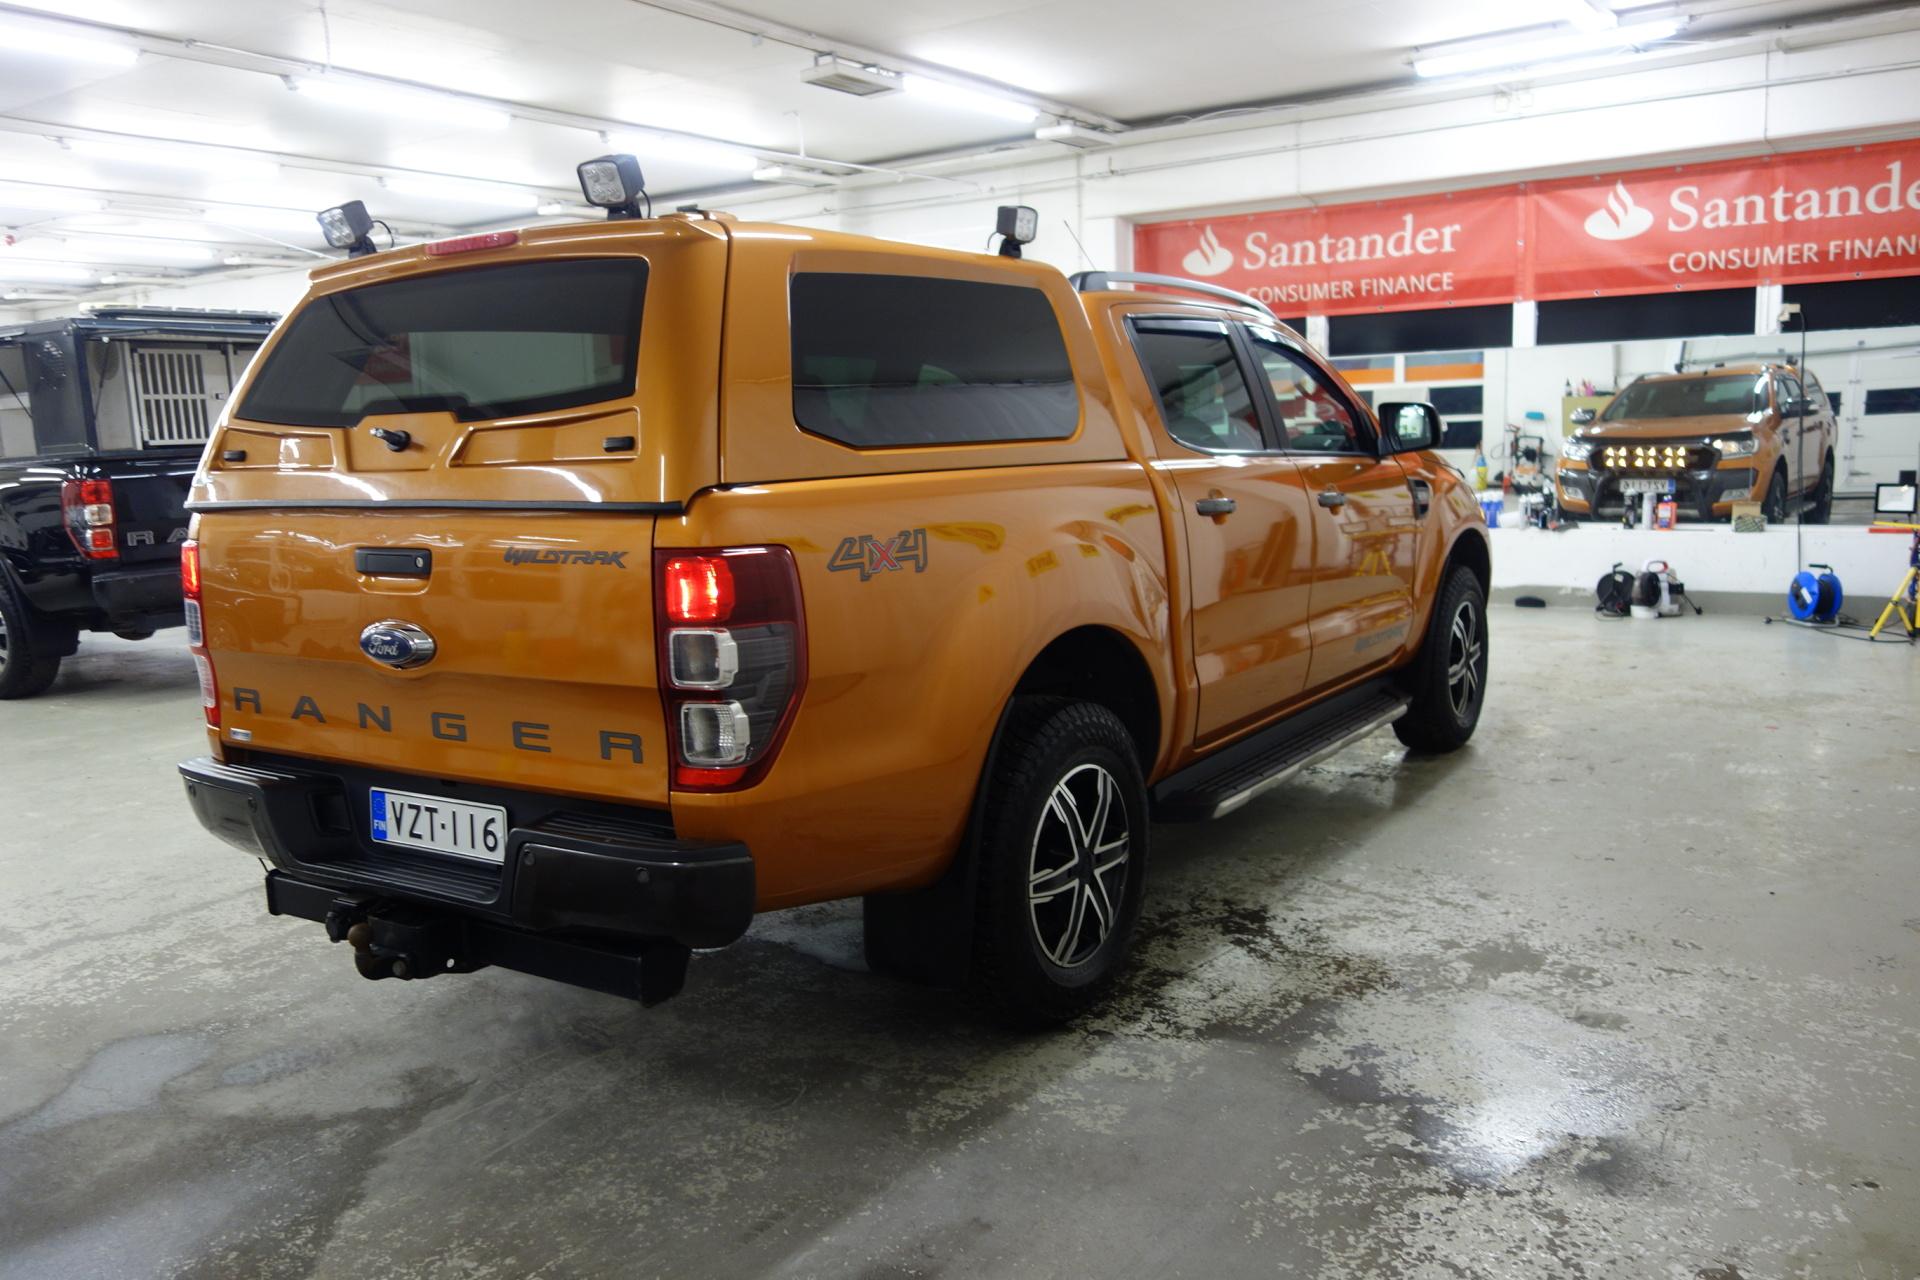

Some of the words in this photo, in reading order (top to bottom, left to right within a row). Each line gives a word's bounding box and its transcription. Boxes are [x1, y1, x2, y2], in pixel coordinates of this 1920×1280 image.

[1243, 212, 1461, 270] Santander
[1668, 241, 1820, 274] CONSUMER
[1828, 234, 1920, 262] FINAN
[1246, 280, 1355, 304] CONSUMER
[1360, 271, 1454, 297] FINANCE
[503, 546, 629, 569] WILDTRAK
[368, 633, 400, 656] Ford
[233, 686, 644, 765] RANGER
[373, 819, 387, 832] FIN
[391, 800, 498, 853] VZT-116
